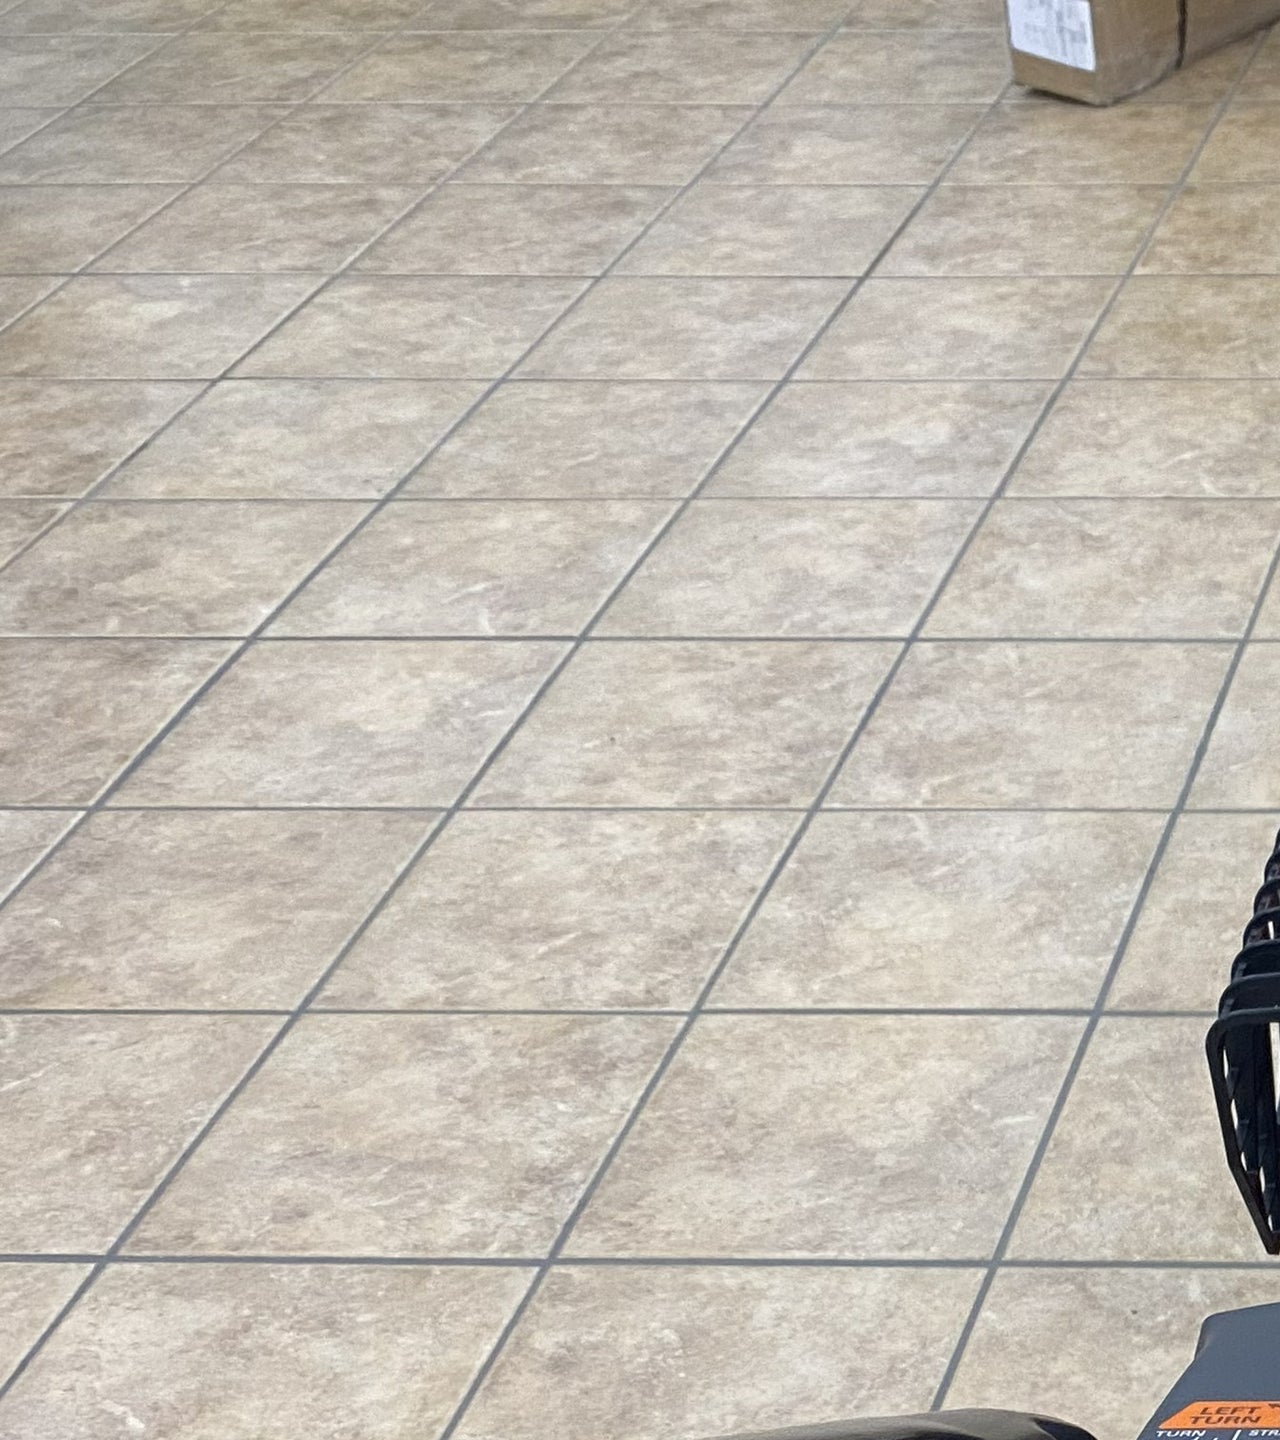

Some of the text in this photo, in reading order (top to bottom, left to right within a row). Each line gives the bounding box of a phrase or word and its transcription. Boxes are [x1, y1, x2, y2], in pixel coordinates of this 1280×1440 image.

[1200, 1406, 1260, 1415] LEFT
[1191, 1416, 1262, 1424] TURN
[1156, 1430, 1206, 1438] TURN
